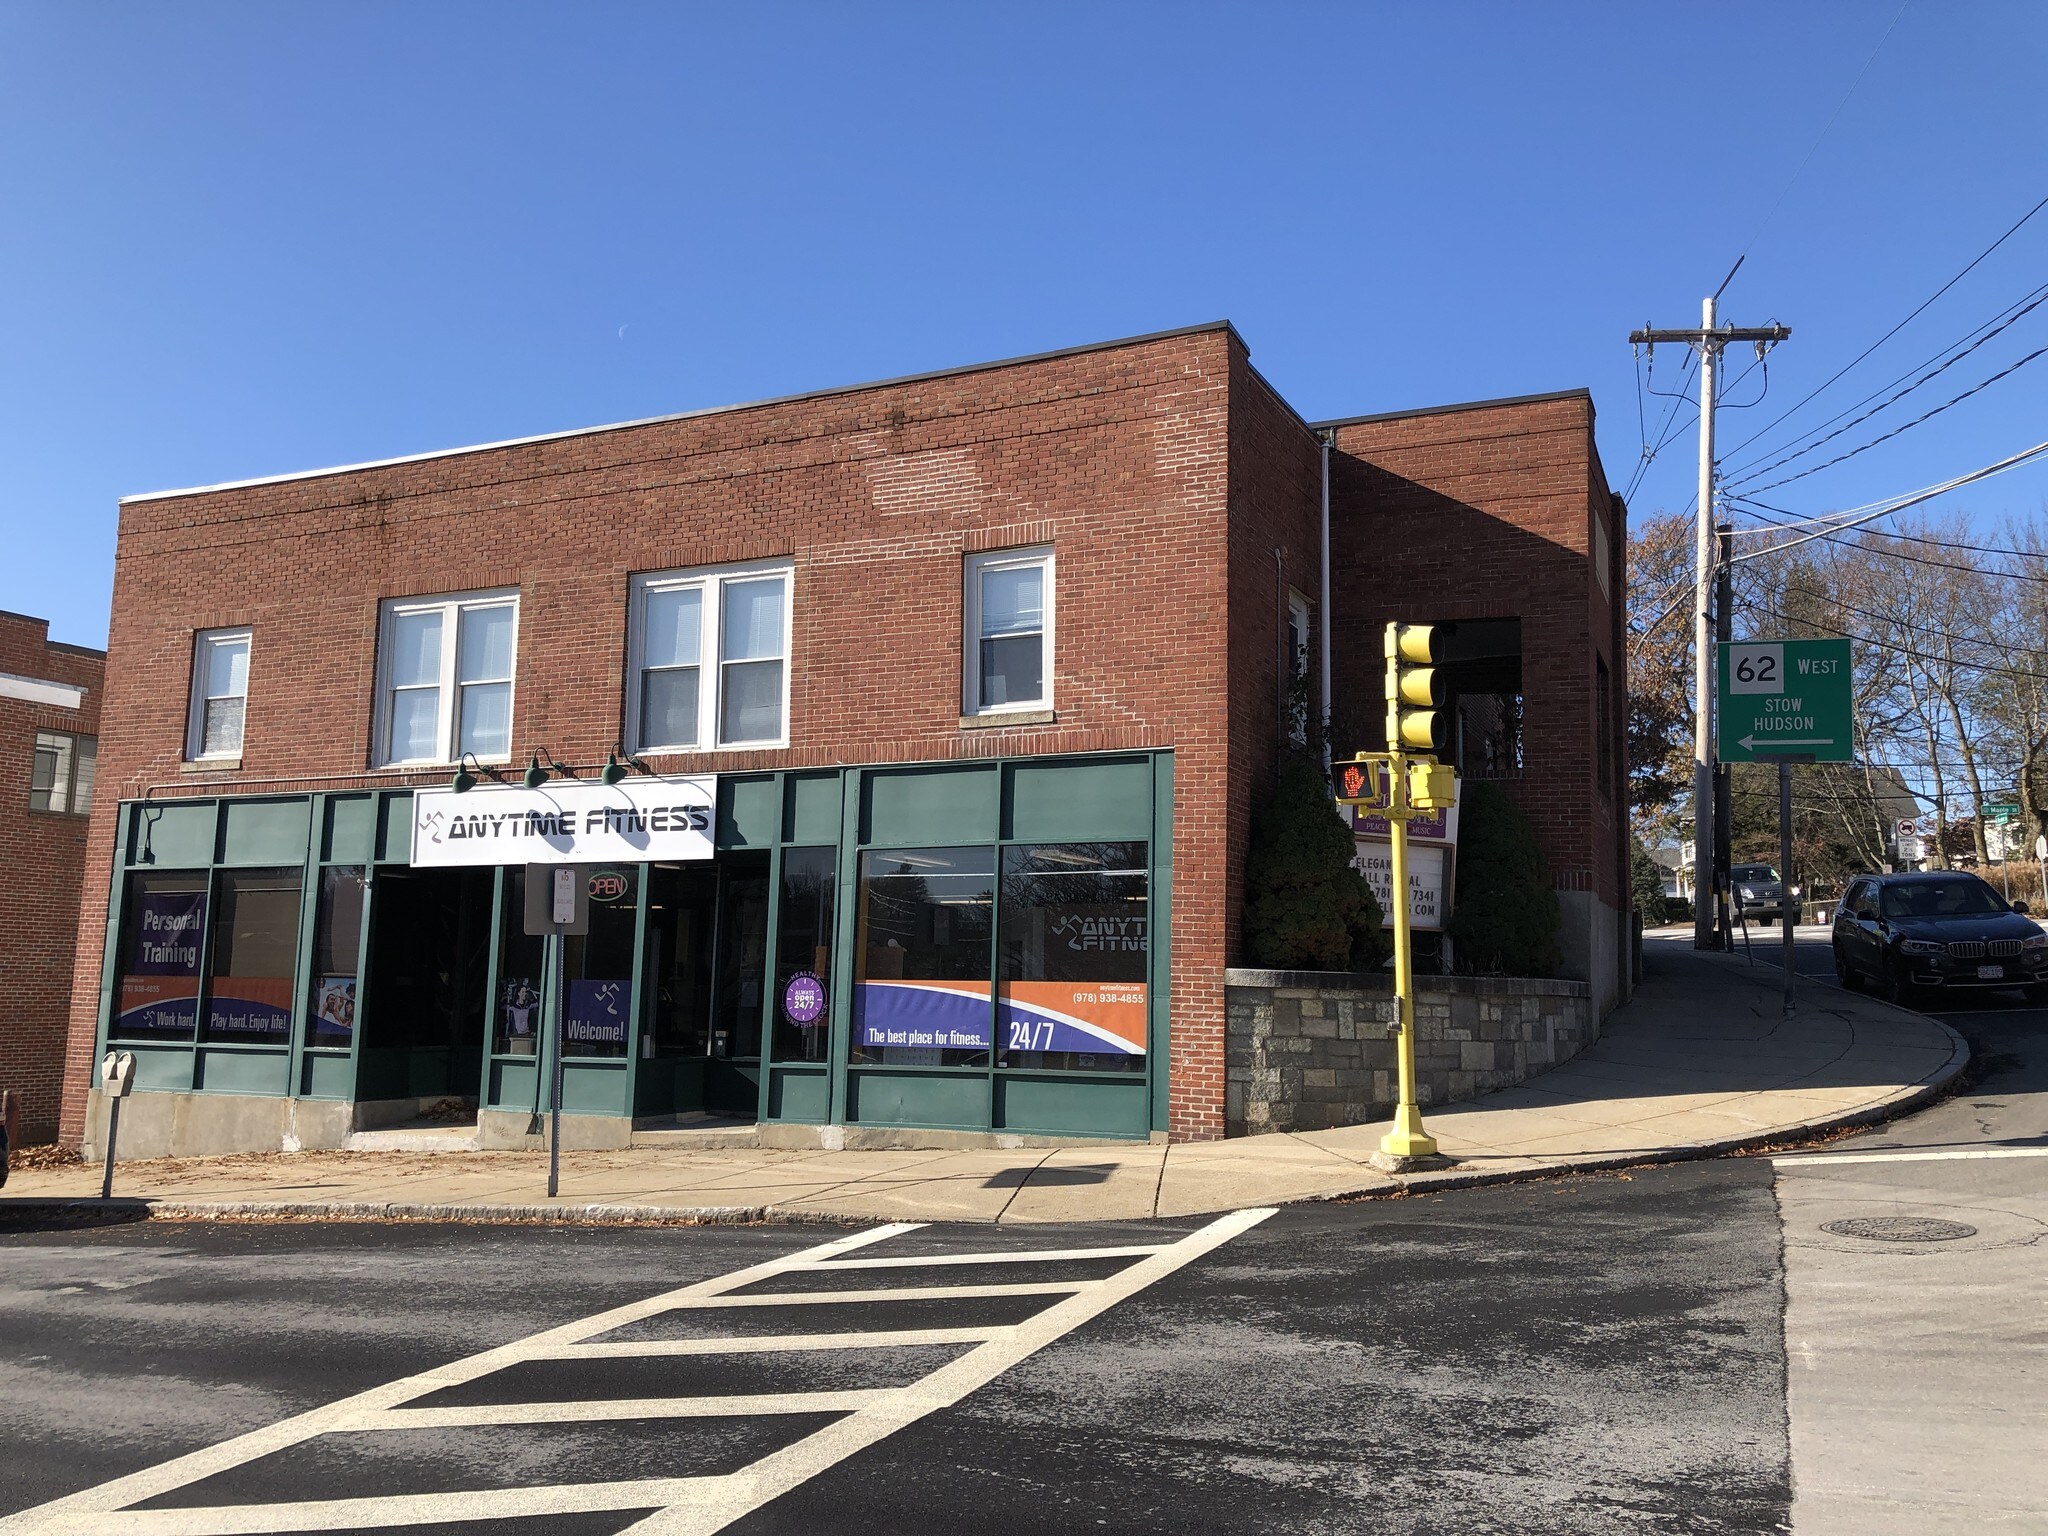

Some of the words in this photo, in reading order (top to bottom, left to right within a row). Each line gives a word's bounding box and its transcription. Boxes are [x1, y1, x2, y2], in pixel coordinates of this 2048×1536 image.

[1736, 656, 1777, 683] 62
[1798, 659, 1838, 674] WEST
[1765, 698, 1802, 712] STOW
[1755, 717, 1814, 731] HUDSON
[448, 811, 576, 840] ANYTIME
[586, 805, 709, 835] FITNESS
[1366, 823, 1387, 832] PEACE
[1412, 827, 1432, 836] MUSIC
[588, 878, 623, 896] OPEN
[1375, 887, 1391, 899] 781
[1413, 890, 1435, 902] 7341
[1415, 904, 1435, 916] COM
[143, 908, 200, 931] Personal
[1081, 917, 1147, 935] ANYT
[143, 941, 196, 969] Training
[794, 1001, 815, 1010] 24/7
[1073, 992, 1097, 1005] (978)
[1099, 993, 1144, 1004] 938-4855
[157, 1011, 176, 1027] Work
[177, 1011, 195, 1027] hard.
[210, 1012, 227, 1031] Play
[229, 1012, 248, 1028] hard.
[249, 1013, 269, 1032] Enjoy
[271, 1013, 287, 1030] life!
[567, 1019, 625, 1041] Welcome!
[868, 1027, 886, 1043] The
[887, 1028, 907, 1044] best
[908, 1028, 933, 1045] place
[935, 1029, 948, 1044] for
[949, 1029, 990, 1046] fitness...
[1009, 1021, 1055, 1050] 24/7
